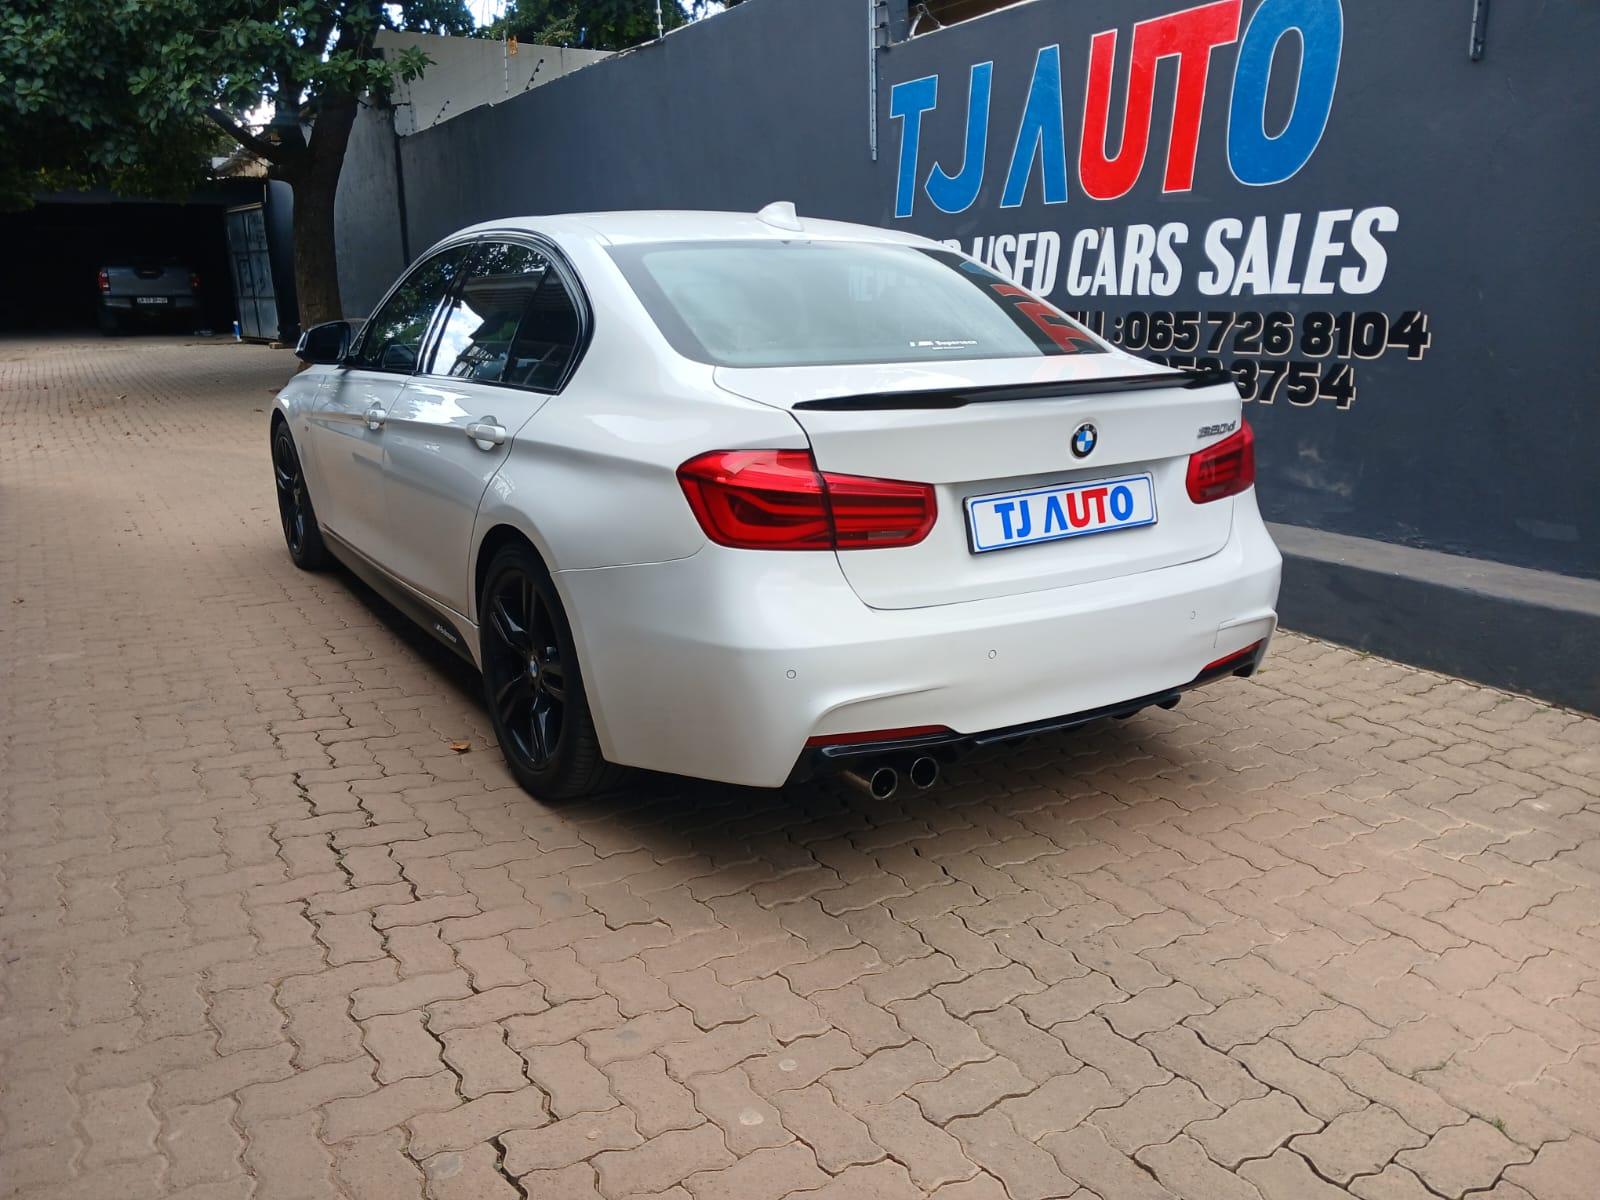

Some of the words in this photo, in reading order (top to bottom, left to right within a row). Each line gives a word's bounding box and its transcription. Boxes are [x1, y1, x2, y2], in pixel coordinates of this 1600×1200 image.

[890, 60, 993, 218] TJ
[1000, 0, 1343, 208] AUTO
[1067, 222, 1189, 296] CARS
[1198, 206, 1399, 296] SALES
[1207, 311, 1294, 357] 726
[1301, 311, 1431, 361] 8104
[1230, 359, 1357, 410] 3754
[994, 500, 1031, 540] TJ
[1044, 485, 1134, 534] AUTO
